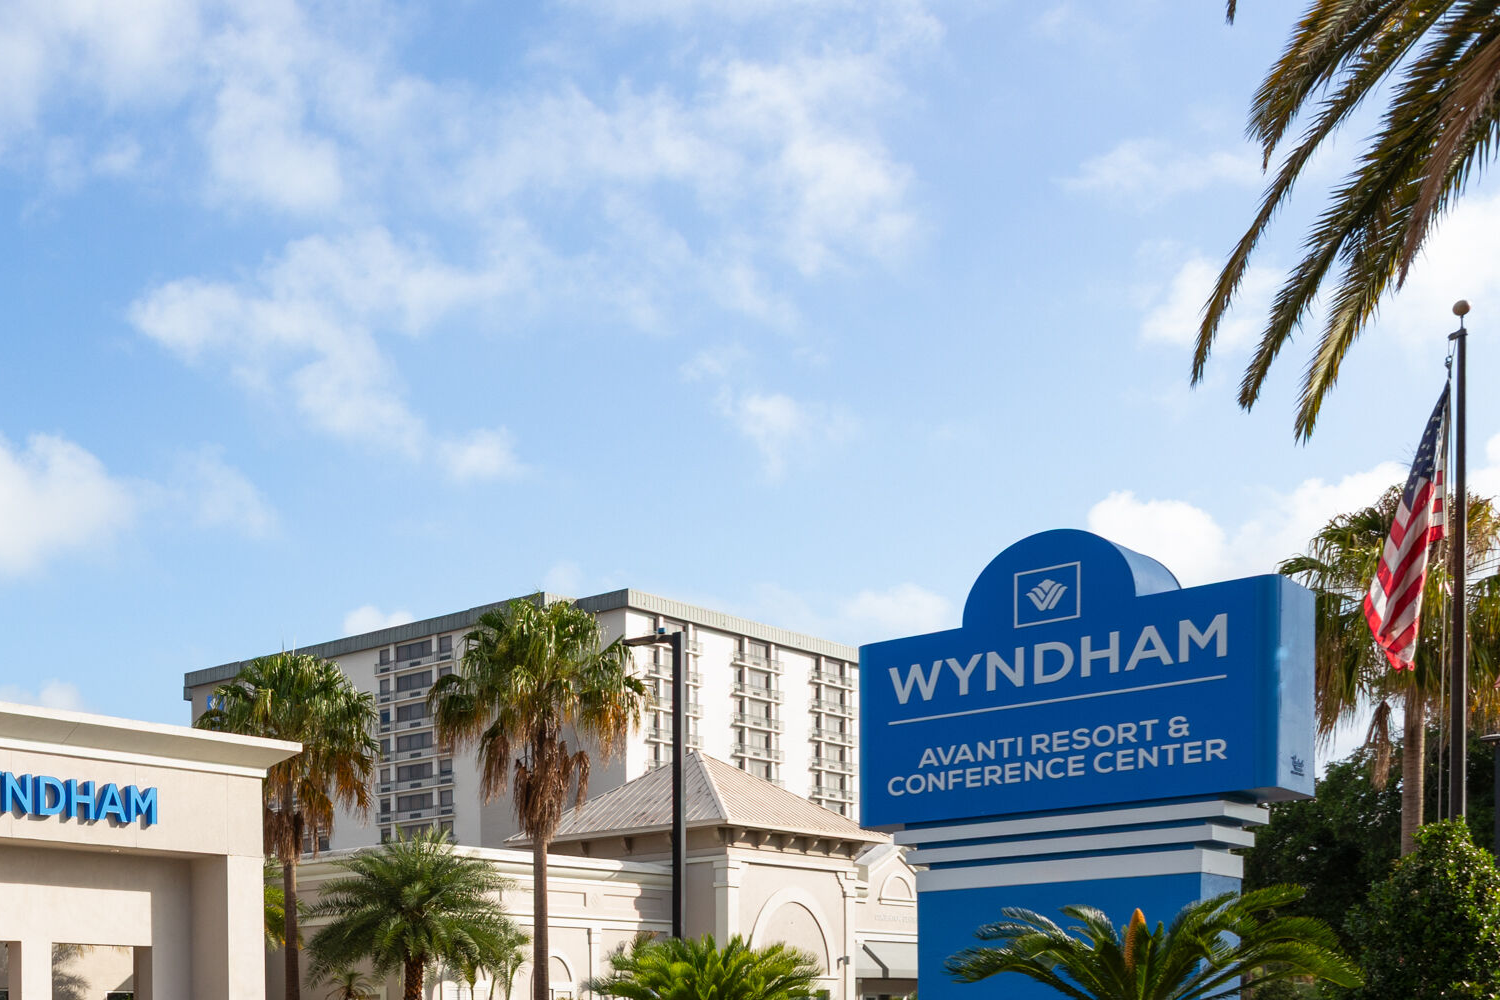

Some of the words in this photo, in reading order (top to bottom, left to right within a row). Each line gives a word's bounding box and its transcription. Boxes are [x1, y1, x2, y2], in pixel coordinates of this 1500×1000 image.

[888, 613, 1229, 705] WYNDHAM
[887, 754, 1086, 797] CONFERENCE
[1093, 738, 1227, 774] CENTER
[917, 736, 1023, 769] AVANTI
[1031, 718, 1160, 755] RESORT
[1167, 715, 1191, 738] &
